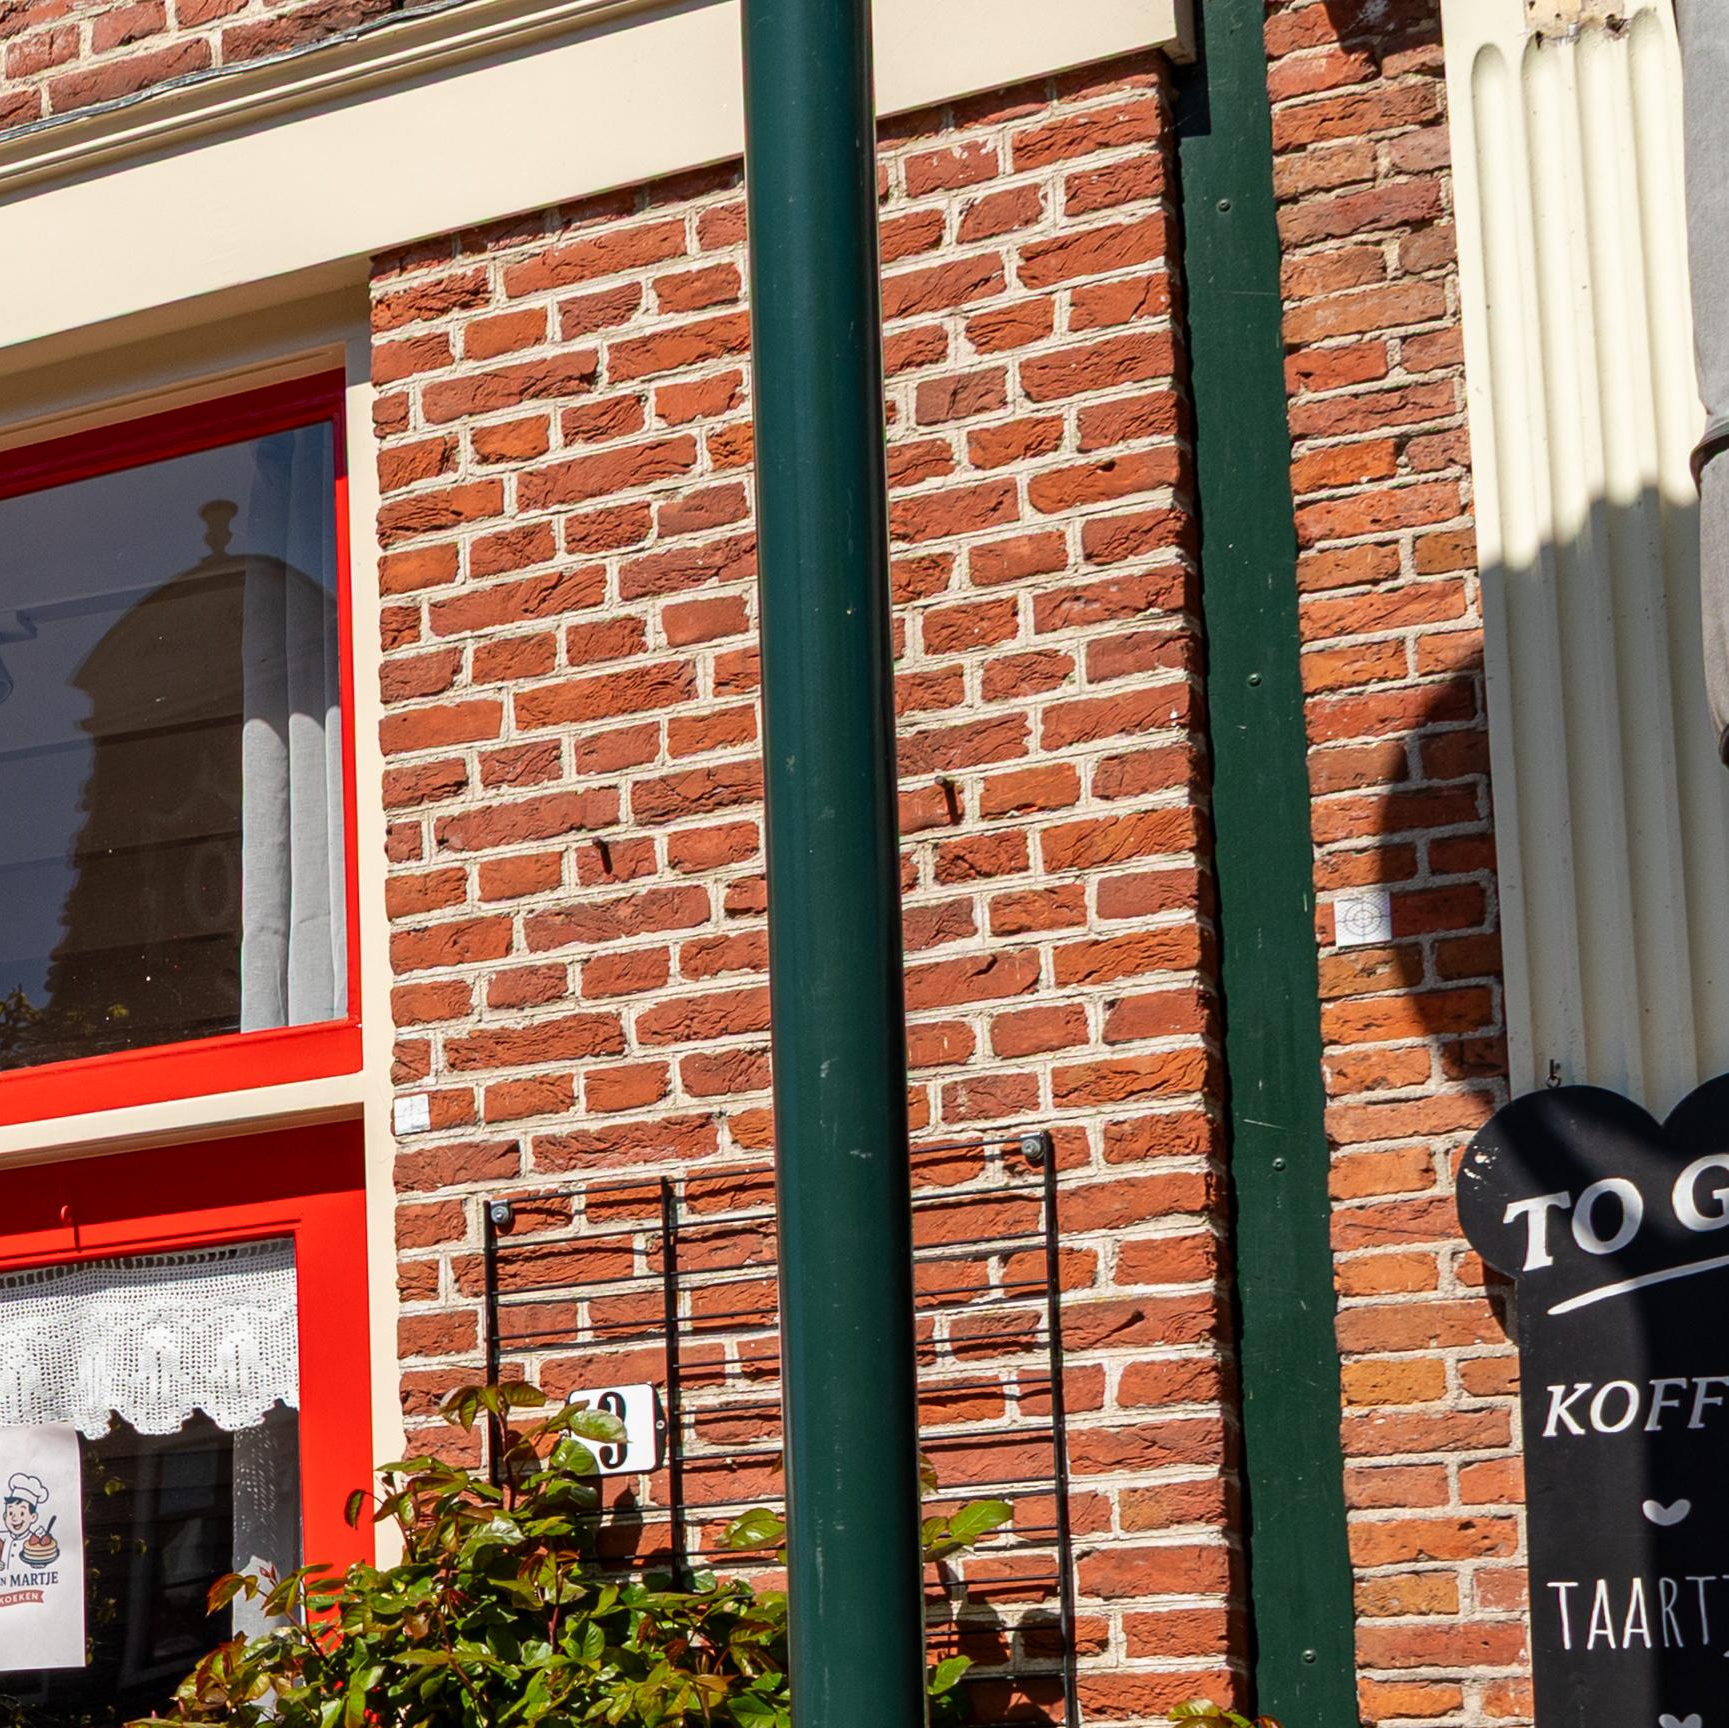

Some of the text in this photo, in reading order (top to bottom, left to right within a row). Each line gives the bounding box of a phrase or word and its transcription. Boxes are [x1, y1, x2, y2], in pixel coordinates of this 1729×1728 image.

[1503, 1178, 1643, 1271] TO
[1542, 1376, 1729, 1438] KOFF
[10, 1571, 59, 1587] MARTJE
[1546, 1574, 1729, 1657] TAART
